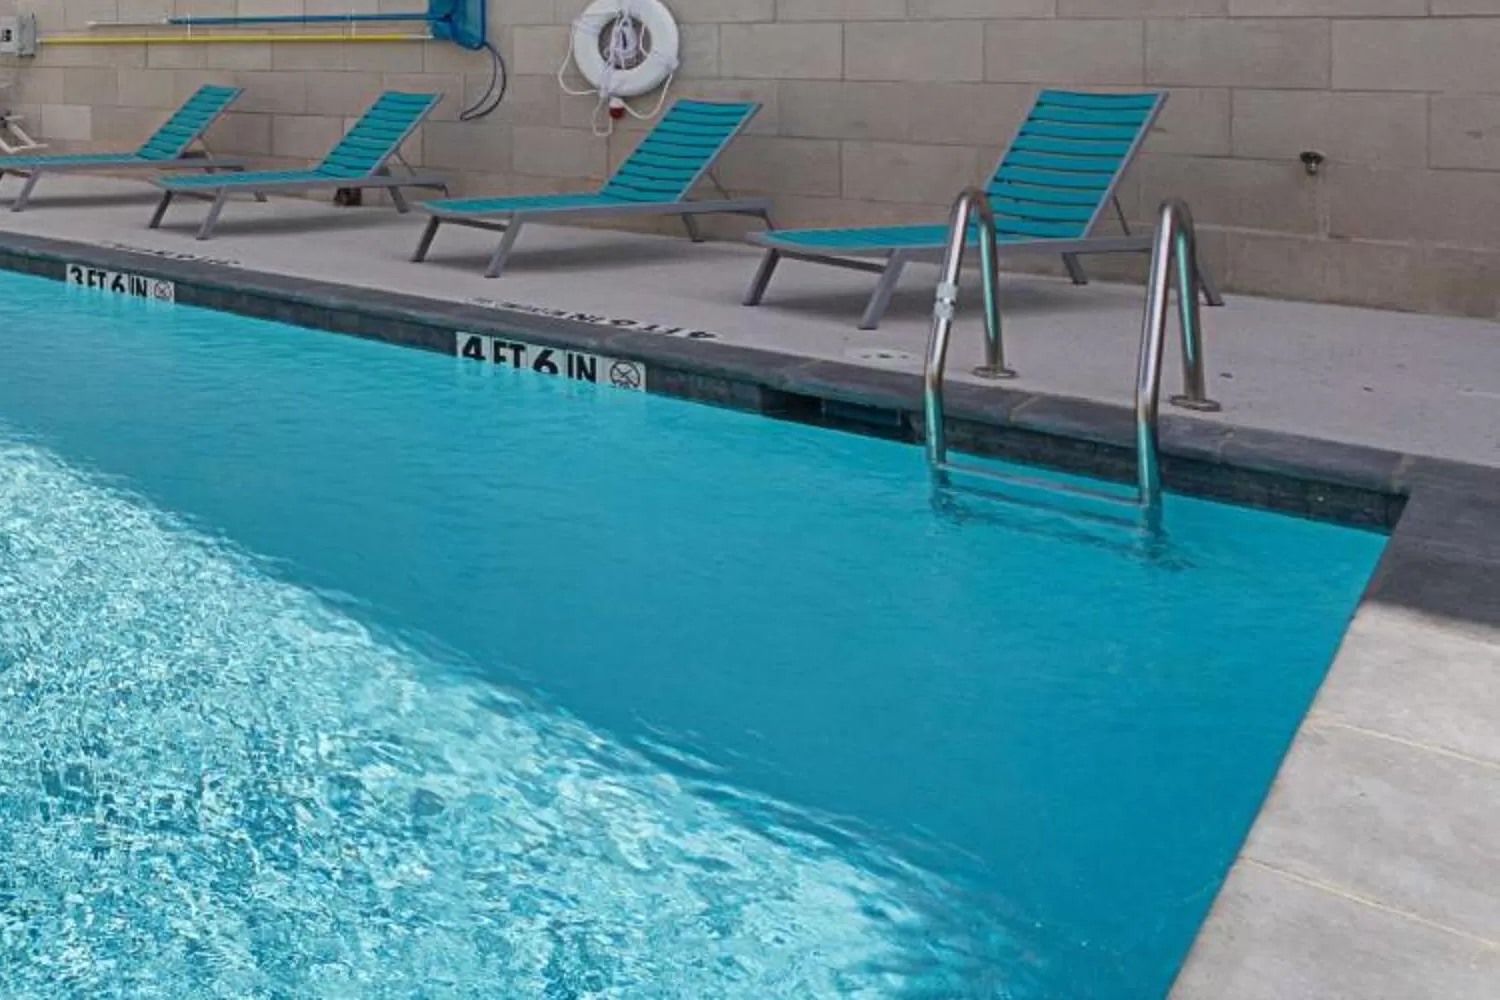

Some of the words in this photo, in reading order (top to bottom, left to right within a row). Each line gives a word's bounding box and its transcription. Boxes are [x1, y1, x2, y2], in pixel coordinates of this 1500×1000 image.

[87, 269, 106, 290] FT
[111, 274, 125, 293] 6
[131, 277, 148, 298] IN
[461, 335, 486, 361] 4
[493, 340, 526, 369] FT
[532, 350, 559, 375] 6
[567, 352, 597, 384] IN
